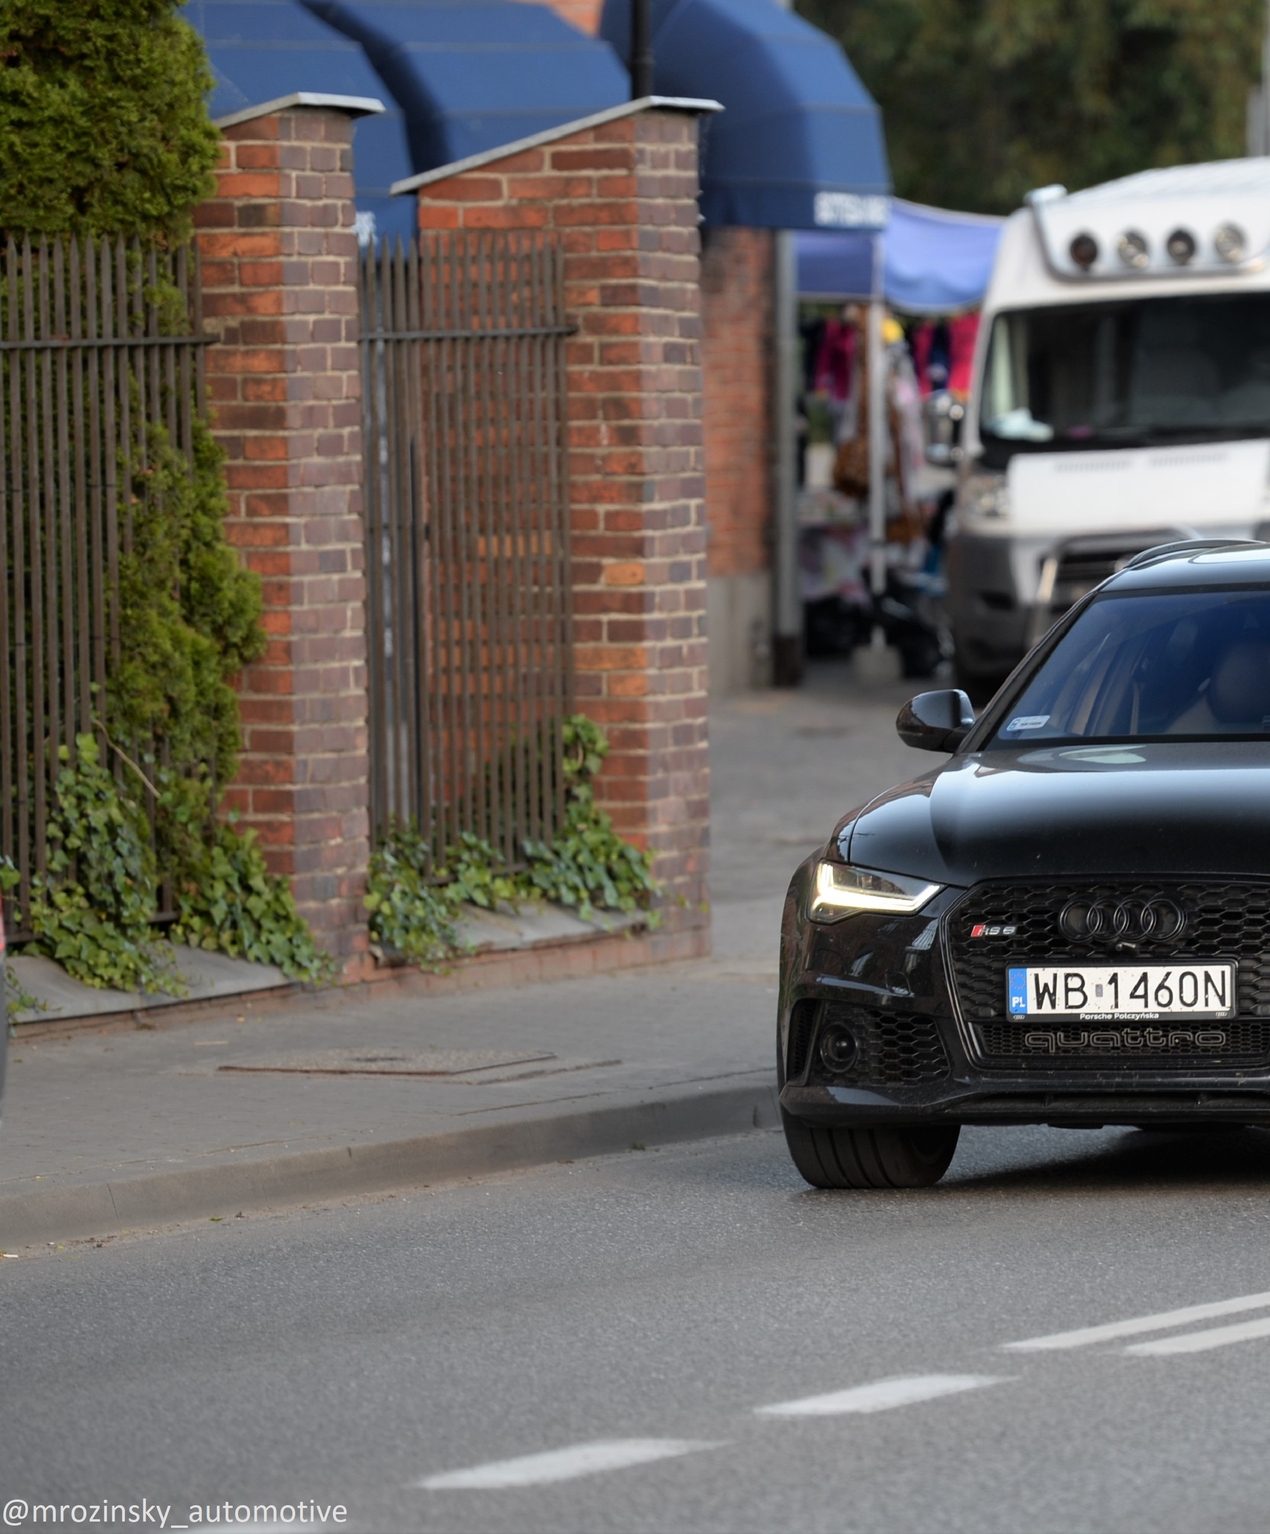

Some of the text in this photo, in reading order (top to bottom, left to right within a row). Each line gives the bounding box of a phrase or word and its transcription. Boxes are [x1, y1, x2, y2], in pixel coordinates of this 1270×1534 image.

[1034, 970, 1226, 1010] WB 1460N
[1012, 997, 1026, 1008] PL
[1025, 1028, 1226, 1051] quattro
